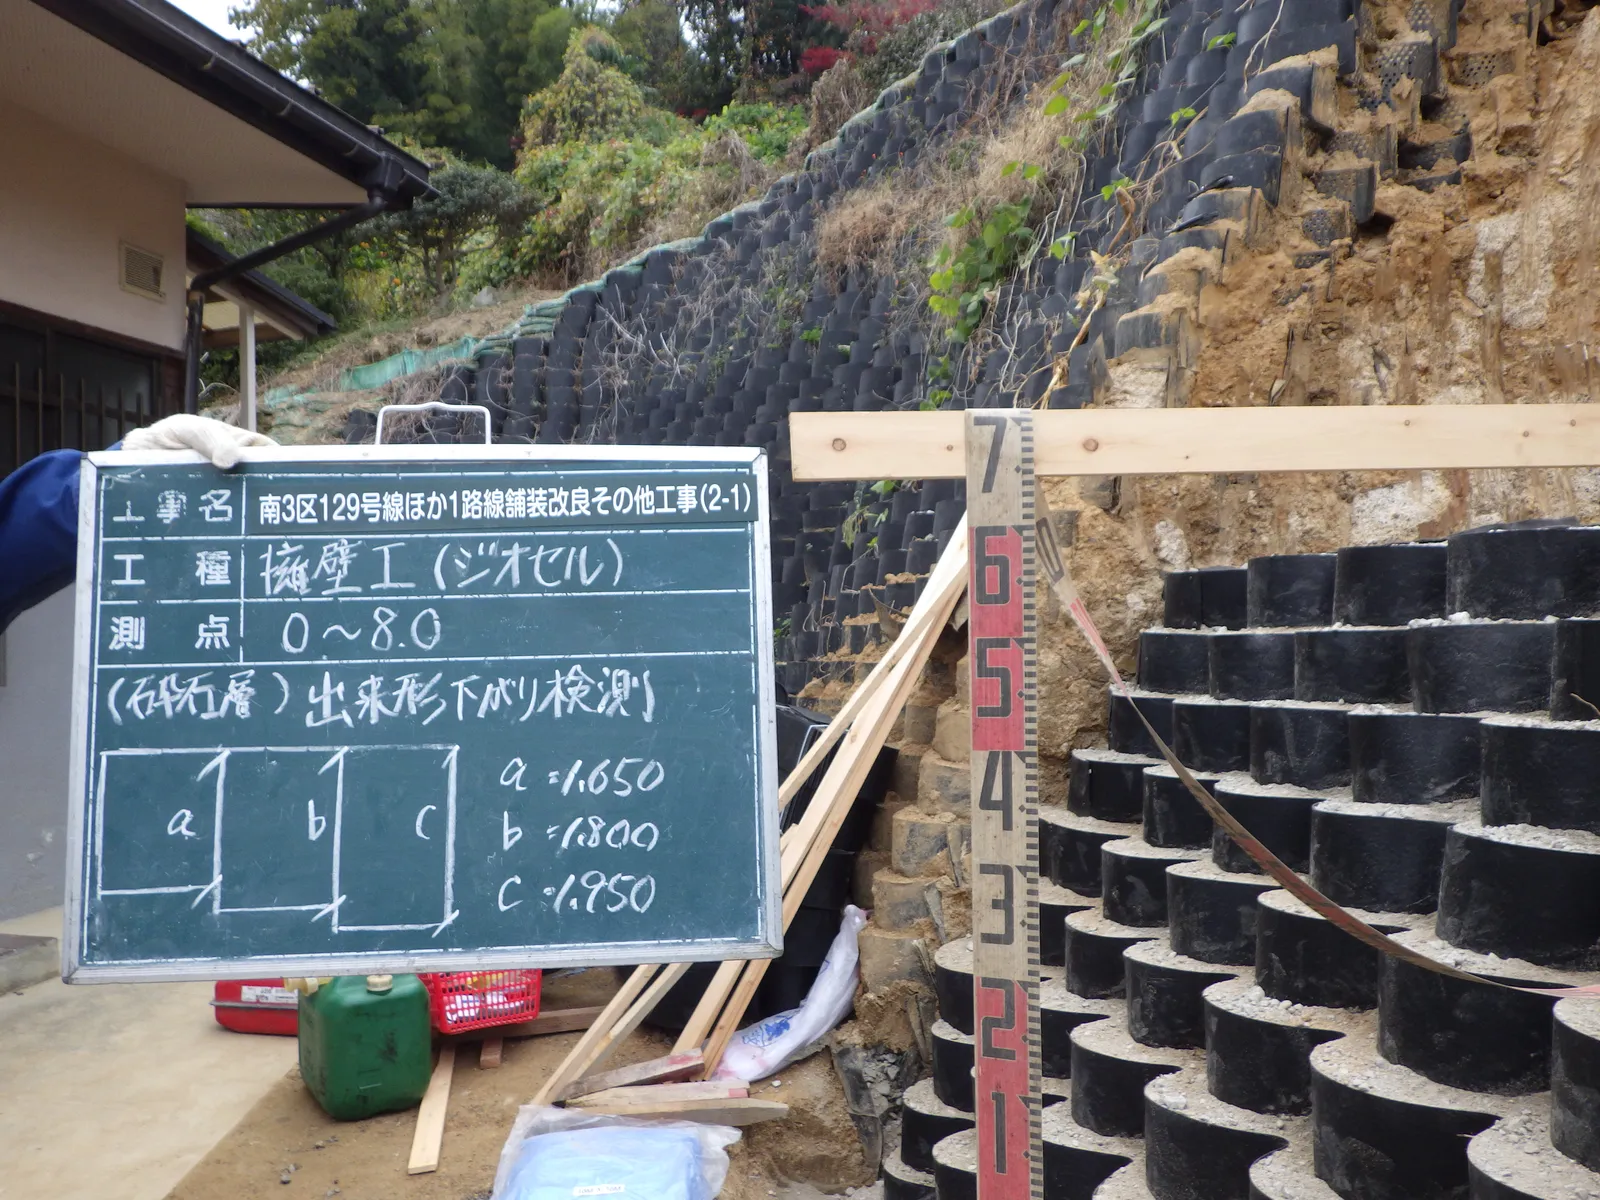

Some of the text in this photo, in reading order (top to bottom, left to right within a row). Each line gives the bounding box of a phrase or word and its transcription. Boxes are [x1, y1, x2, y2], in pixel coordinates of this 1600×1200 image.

[973, 416, 1008, 494] 7
[975, 526, 1011, 606] 6
[976, 637, 1012, 718] 5
[166, 808, 197, 838] a
[307, 799, 326, 841] b
[978, 750, 1013, 831] 4
[979, 863, 1015, 945] 3
[980, 977, 1016, 1060] 2
[991, 1091, 1007, 1174] 1
